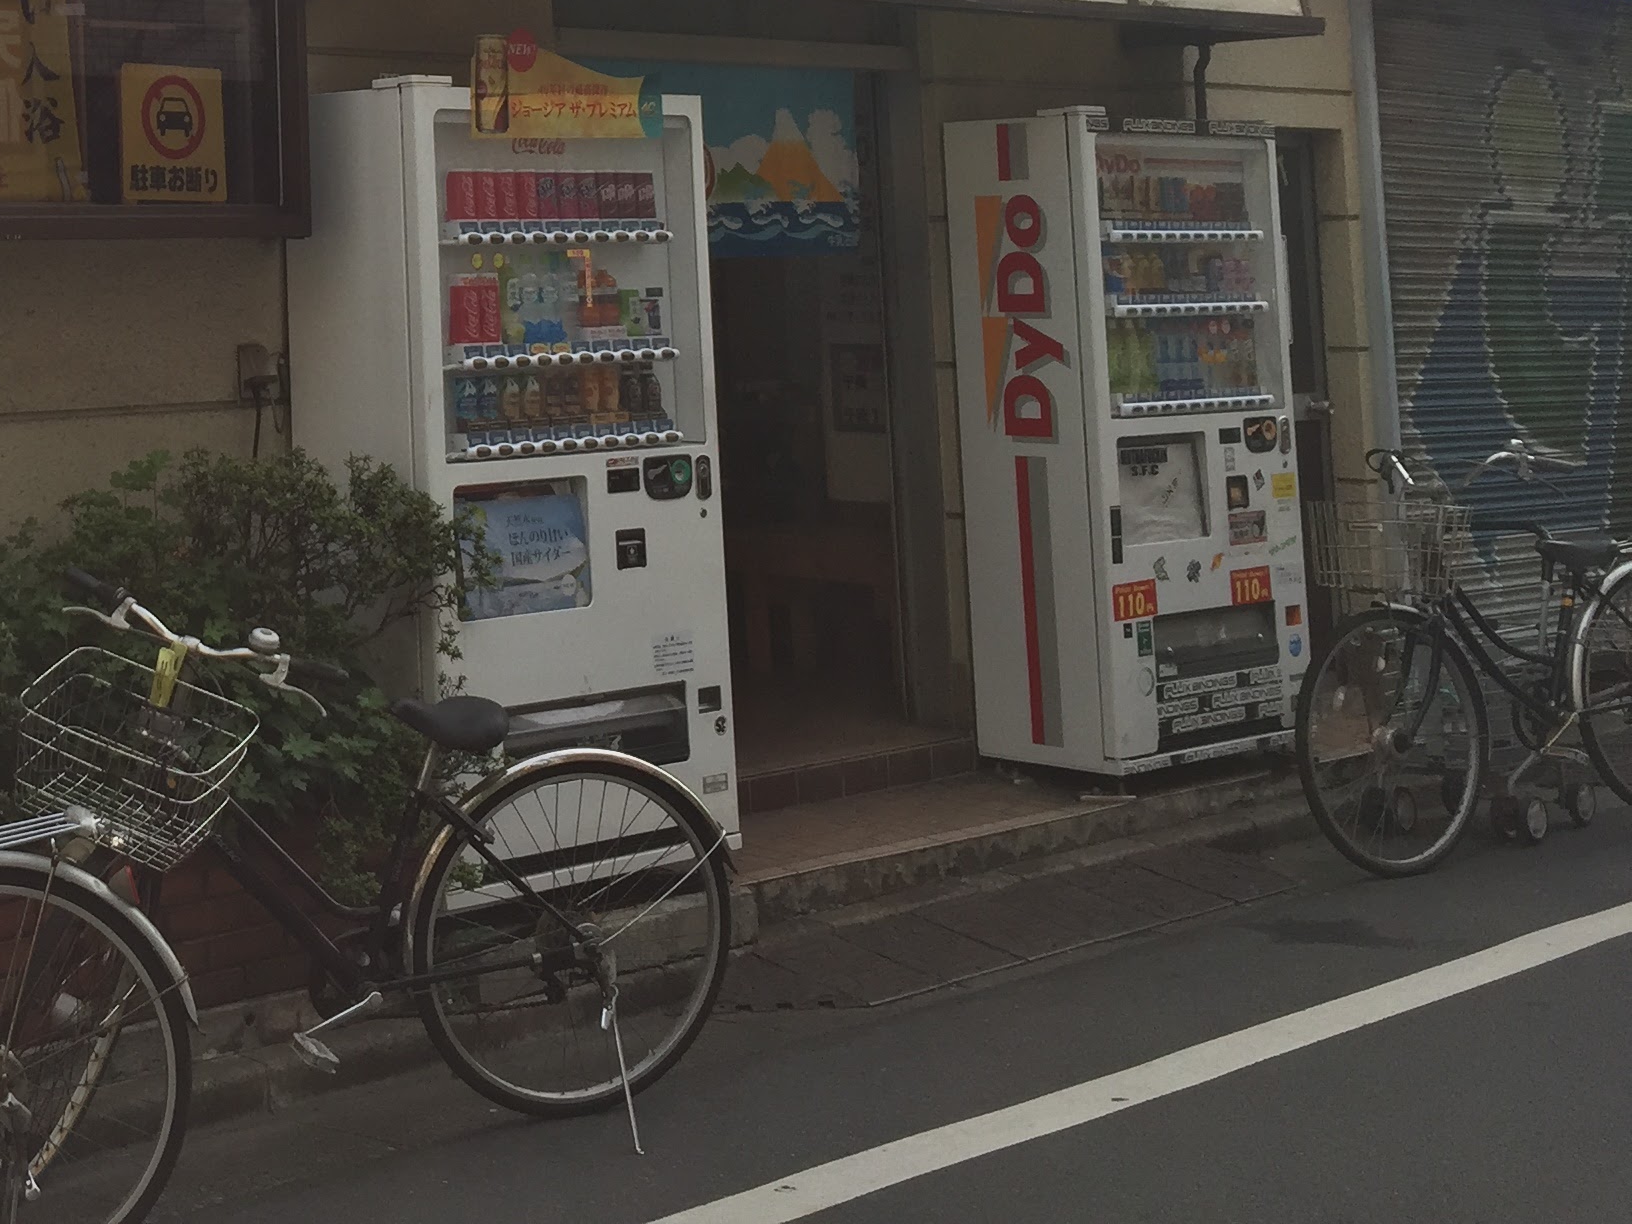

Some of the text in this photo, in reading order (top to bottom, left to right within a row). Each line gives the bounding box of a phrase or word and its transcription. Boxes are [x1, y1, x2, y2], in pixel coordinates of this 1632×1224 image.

[511, 101, 567, 119] ジョージア
[569, 100, 637, 119] ザ・プレミアム
[129, 163, 218, 194] 駐車お断り
[996, 193, 1066, 438] DyDo
[508, 527, 570, 547] ほんのり甘い
[510, 545, 572, 568] 国産サイダー
